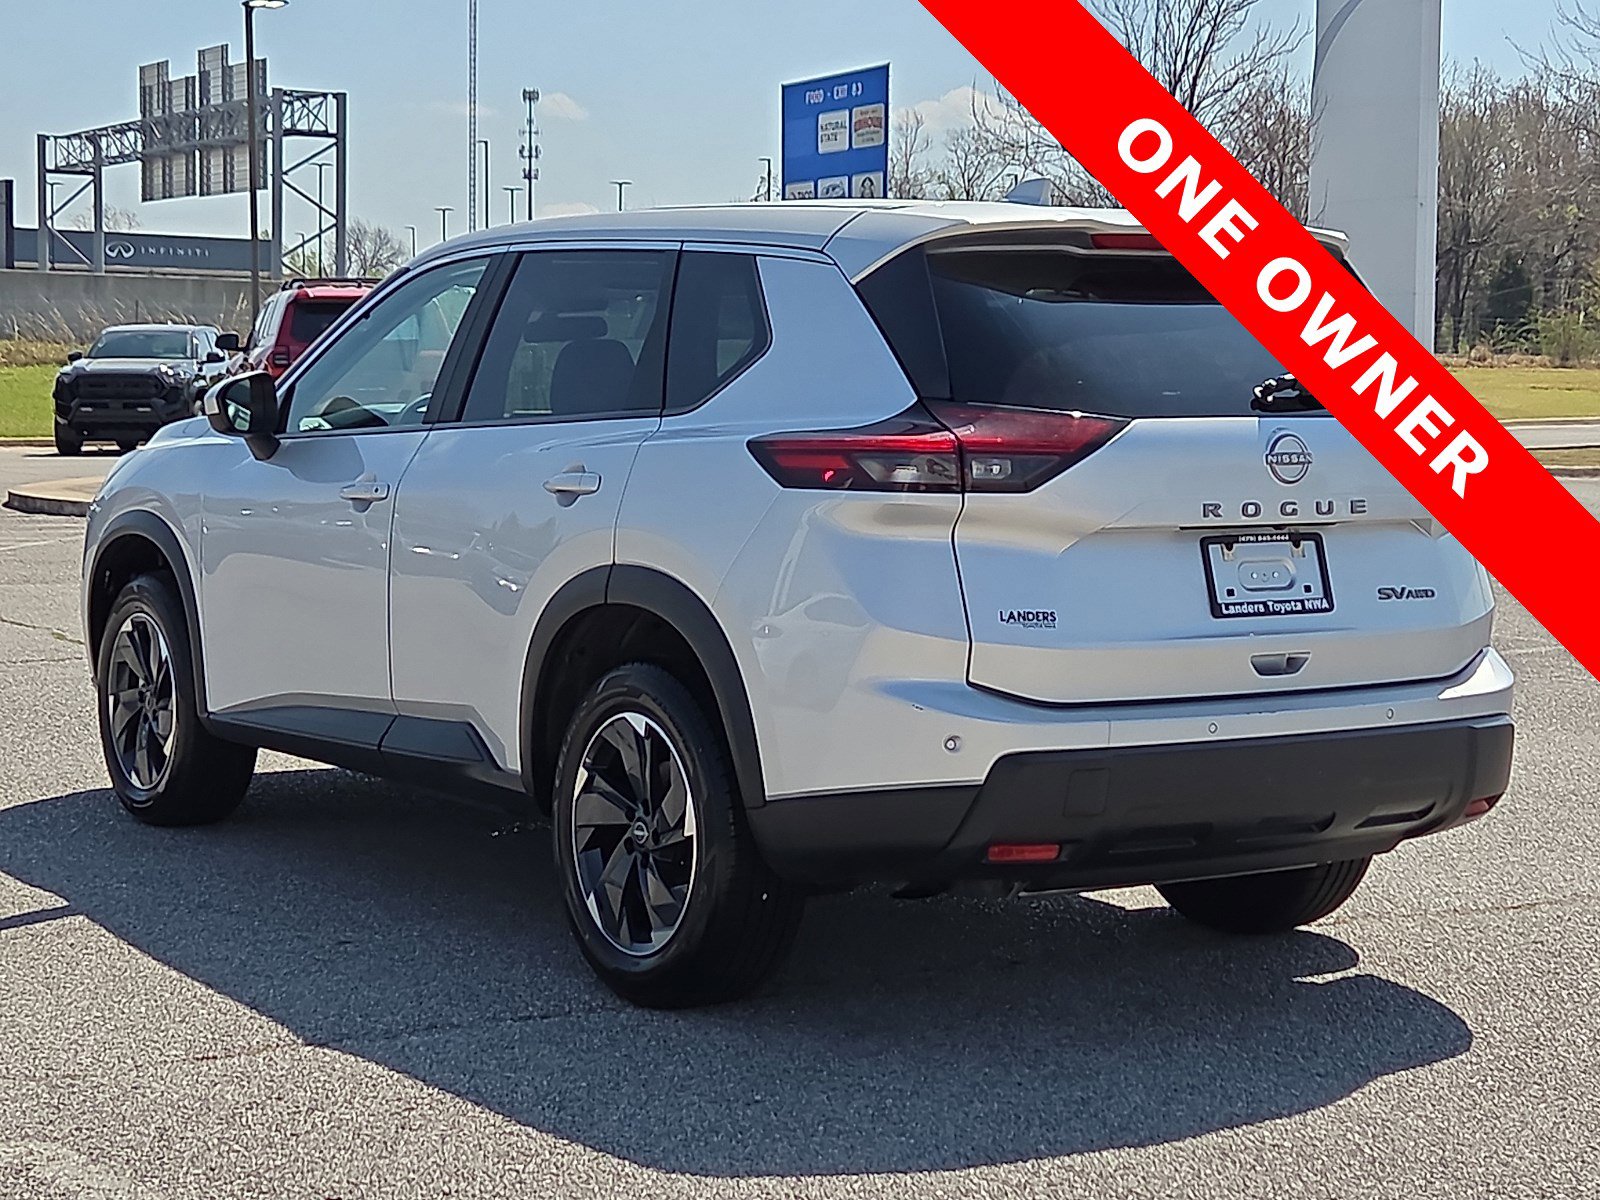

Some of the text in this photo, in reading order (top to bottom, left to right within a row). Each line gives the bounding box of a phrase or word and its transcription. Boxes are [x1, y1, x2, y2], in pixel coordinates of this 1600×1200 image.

[140, 246, 209, 257] INFINITI
[1267, 454, 1313, 464] NISSAN
[1202, 499, 1367, 518] ROGUE
[1221, 598, 1330, 615] Landers Toyota NWA
[999, 610, 1057, 623] LANDERS
